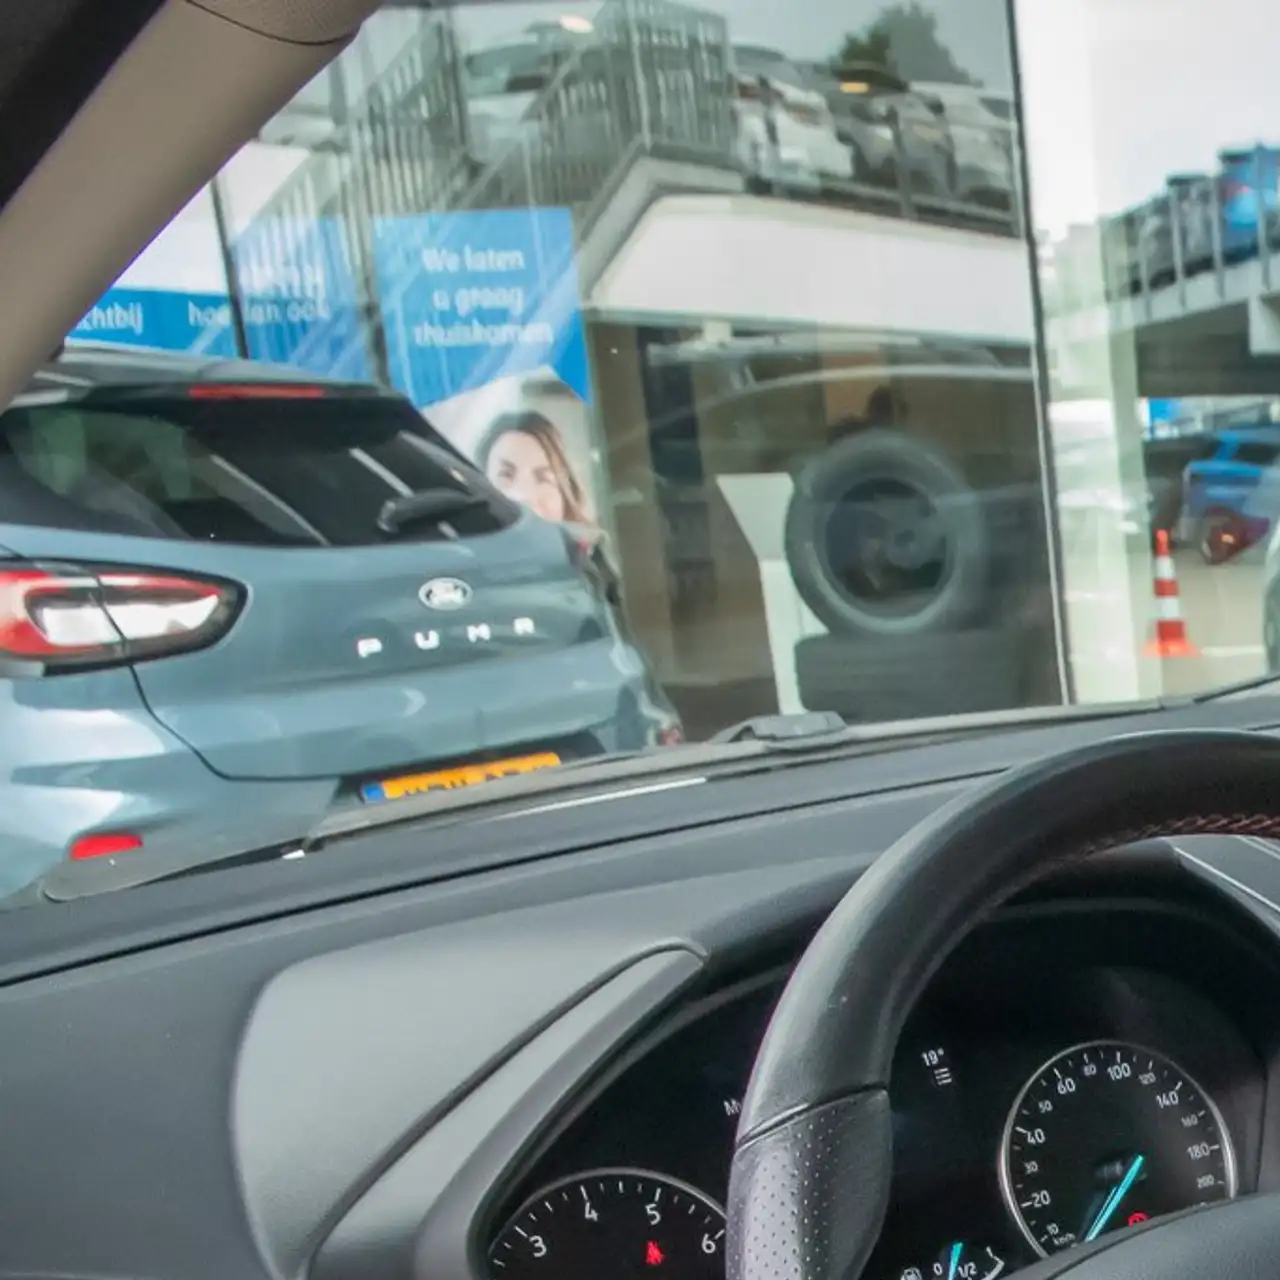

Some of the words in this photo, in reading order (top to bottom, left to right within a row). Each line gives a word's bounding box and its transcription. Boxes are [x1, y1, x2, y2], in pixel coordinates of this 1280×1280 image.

[422, 248, 460, 272] We
[464, 244, 526, 272] laten
[455, 287, 524, 318] graag
[357, 617, 536, 658] PUMA
[1107, 1062, 1131, 1081] 100
[1138, 1072, 1156, 1085] 120
[1057, 1077, 1076, 1095] 60
[1038, 1100, 1053, 1114] 50
[1156, 1091, 1179, 1109] 140
[1181, 1114, 1198, 1127] 160
[1026, 1128, 1045, 1145] 40
[1186, 1143, 1210, 1160] 180
[1024, 1161, 1038, 1174] 30
[1196, 1175, 1215, 1189] 200
[1031, 1189, 1051, 1208] 20
[583, 1201, 599, 1222] 4
[645, 1203, 661, 1225] 5
[529, 1235, 547, 1257] 3
[701, 1233, 716, 1254] 6
